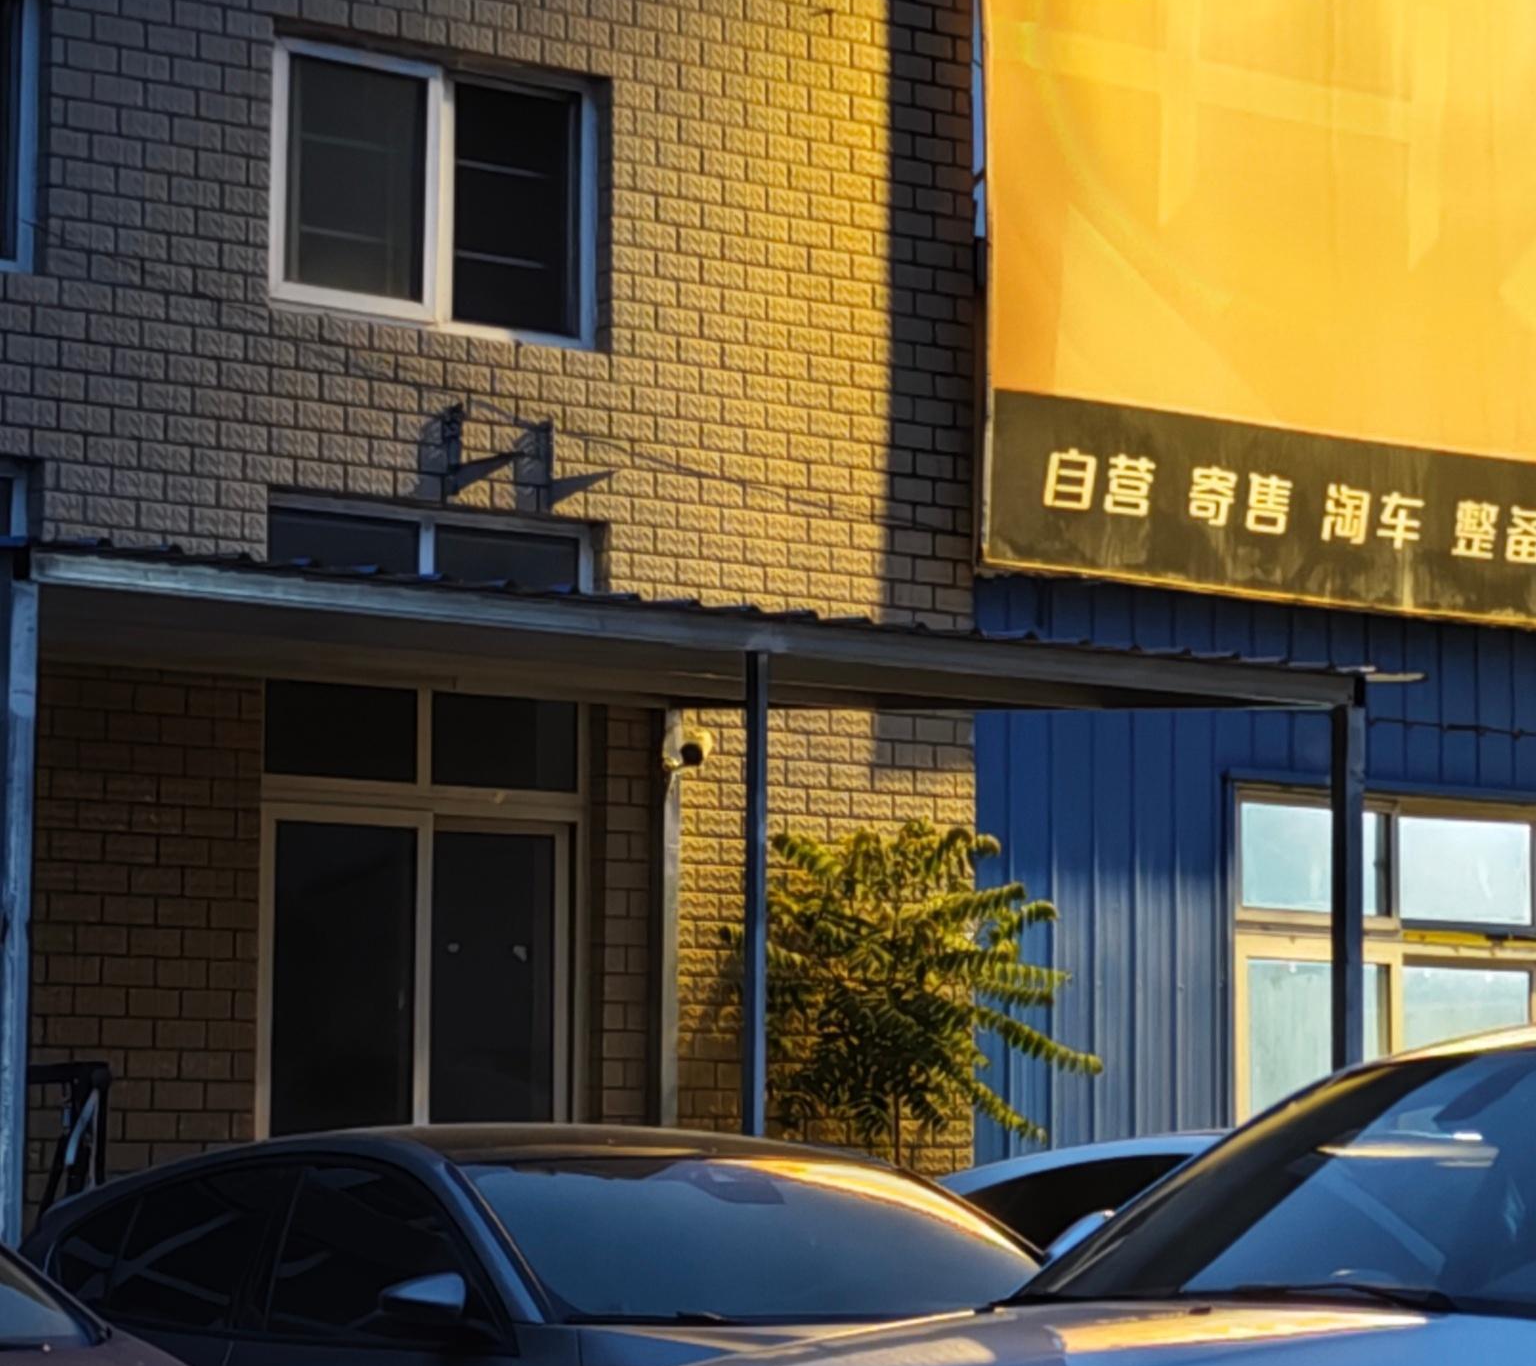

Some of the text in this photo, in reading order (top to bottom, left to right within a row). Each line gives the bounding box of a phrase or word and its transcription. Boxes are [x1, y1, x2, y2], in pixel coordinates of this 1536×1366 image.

[1043, 447, 1156, 517] 自营
[1188, 465, 1293, 535] 寄售
[1320, 482, 1425, 549] 淘车
